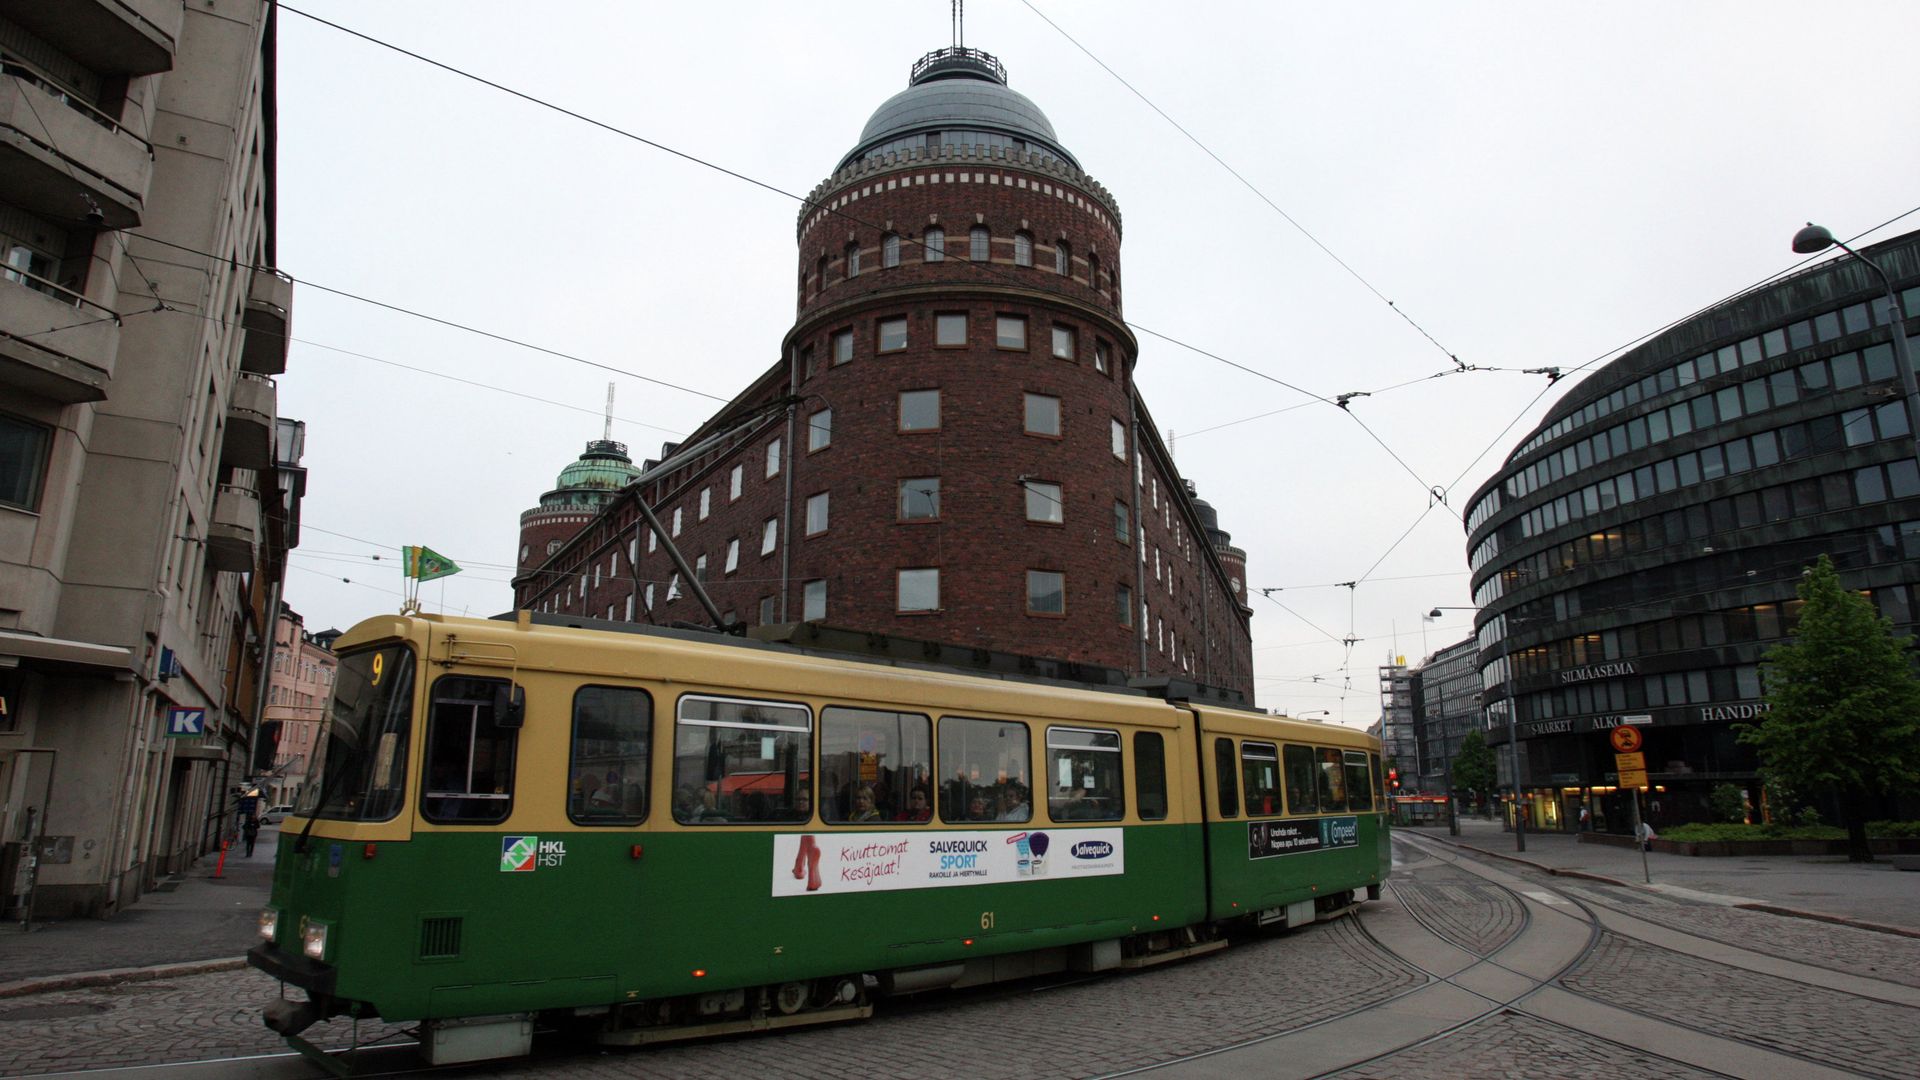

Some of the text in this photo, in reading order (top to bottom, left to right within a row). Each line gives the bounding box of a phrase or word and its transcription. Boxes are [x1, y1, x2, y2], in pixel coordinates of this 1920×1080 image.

[372, 653, 383, 686] 9
[1562, 662, 1634, 683] SILMÄASEMA
[173, 711, 201, 733] K
[1531, 719, 1573, 735] S-MARKET
[539, 841, 566, 853] HKL
[840, 839, 909, 862] Kivuttomat
[930, 840, 988, 854] SALVEQUICK
[1076, 841, 1111, 858] Salvequick
[538, 853, 566, 866] HST
[941, 854, 978, 870] SPORT
[981, 911, 993, 929] 61
